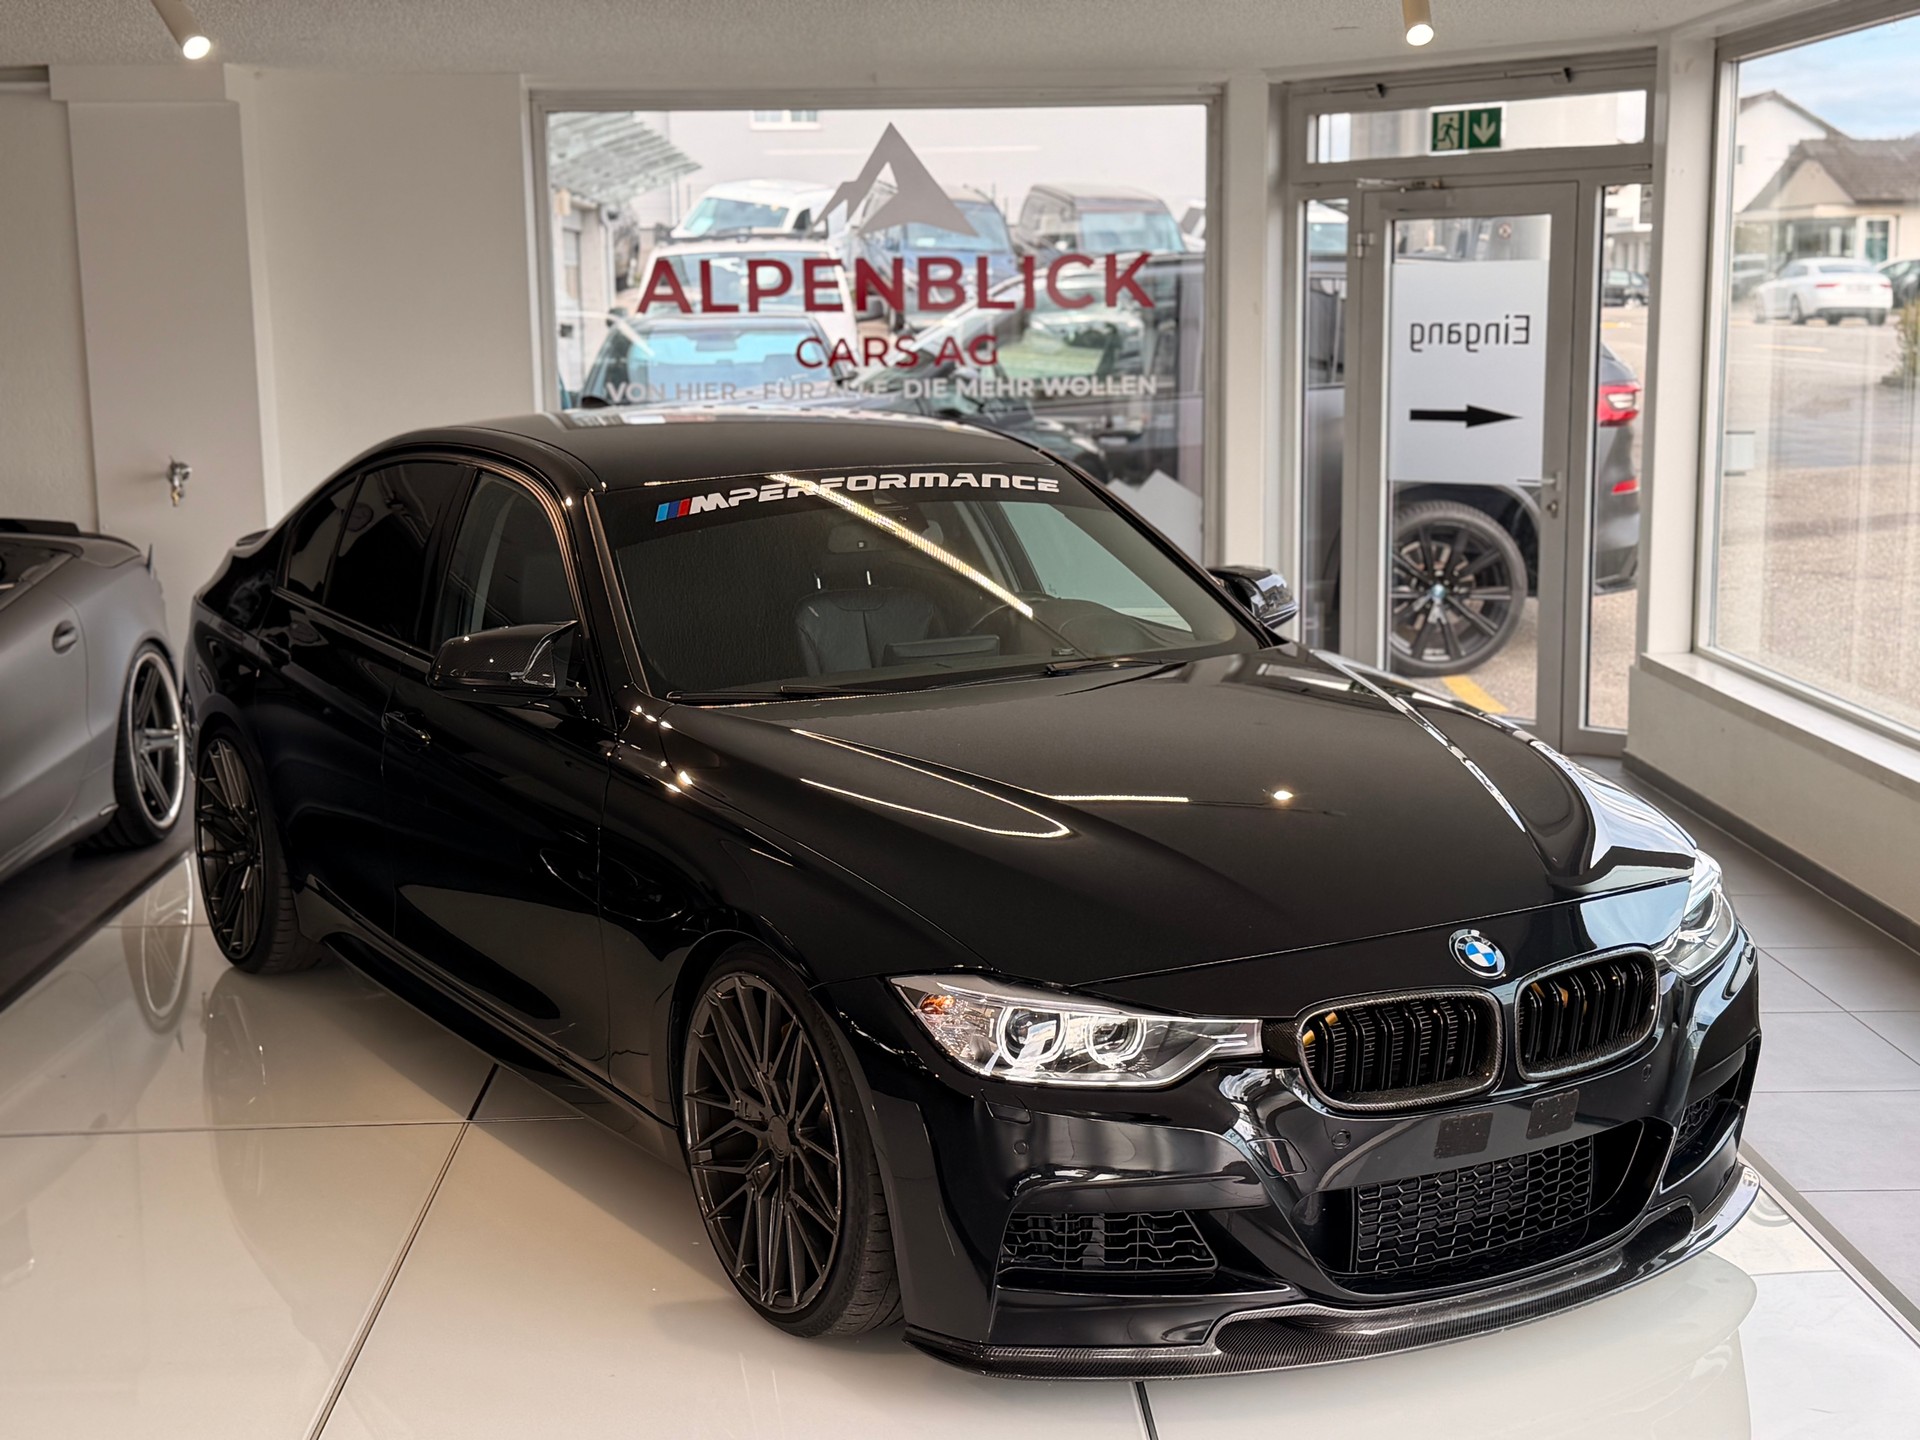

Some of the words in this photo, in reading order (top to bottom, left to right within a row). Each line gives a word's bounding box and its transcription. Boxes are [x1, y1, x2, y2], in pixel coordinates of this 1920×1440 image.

[636, 252, 1156, 314] ALPENBLICK
[795, 335, 920, 368] CARS
[934, 334, 999, 367] AG
[606, 381, 665, 402] VON
[675, 381, 737, 401] HIER
[903, 378, 948, 399] DIE
[956, 377, 1036, 399] MEHR
[1041, 374, 1158, 397] WOLLEN
